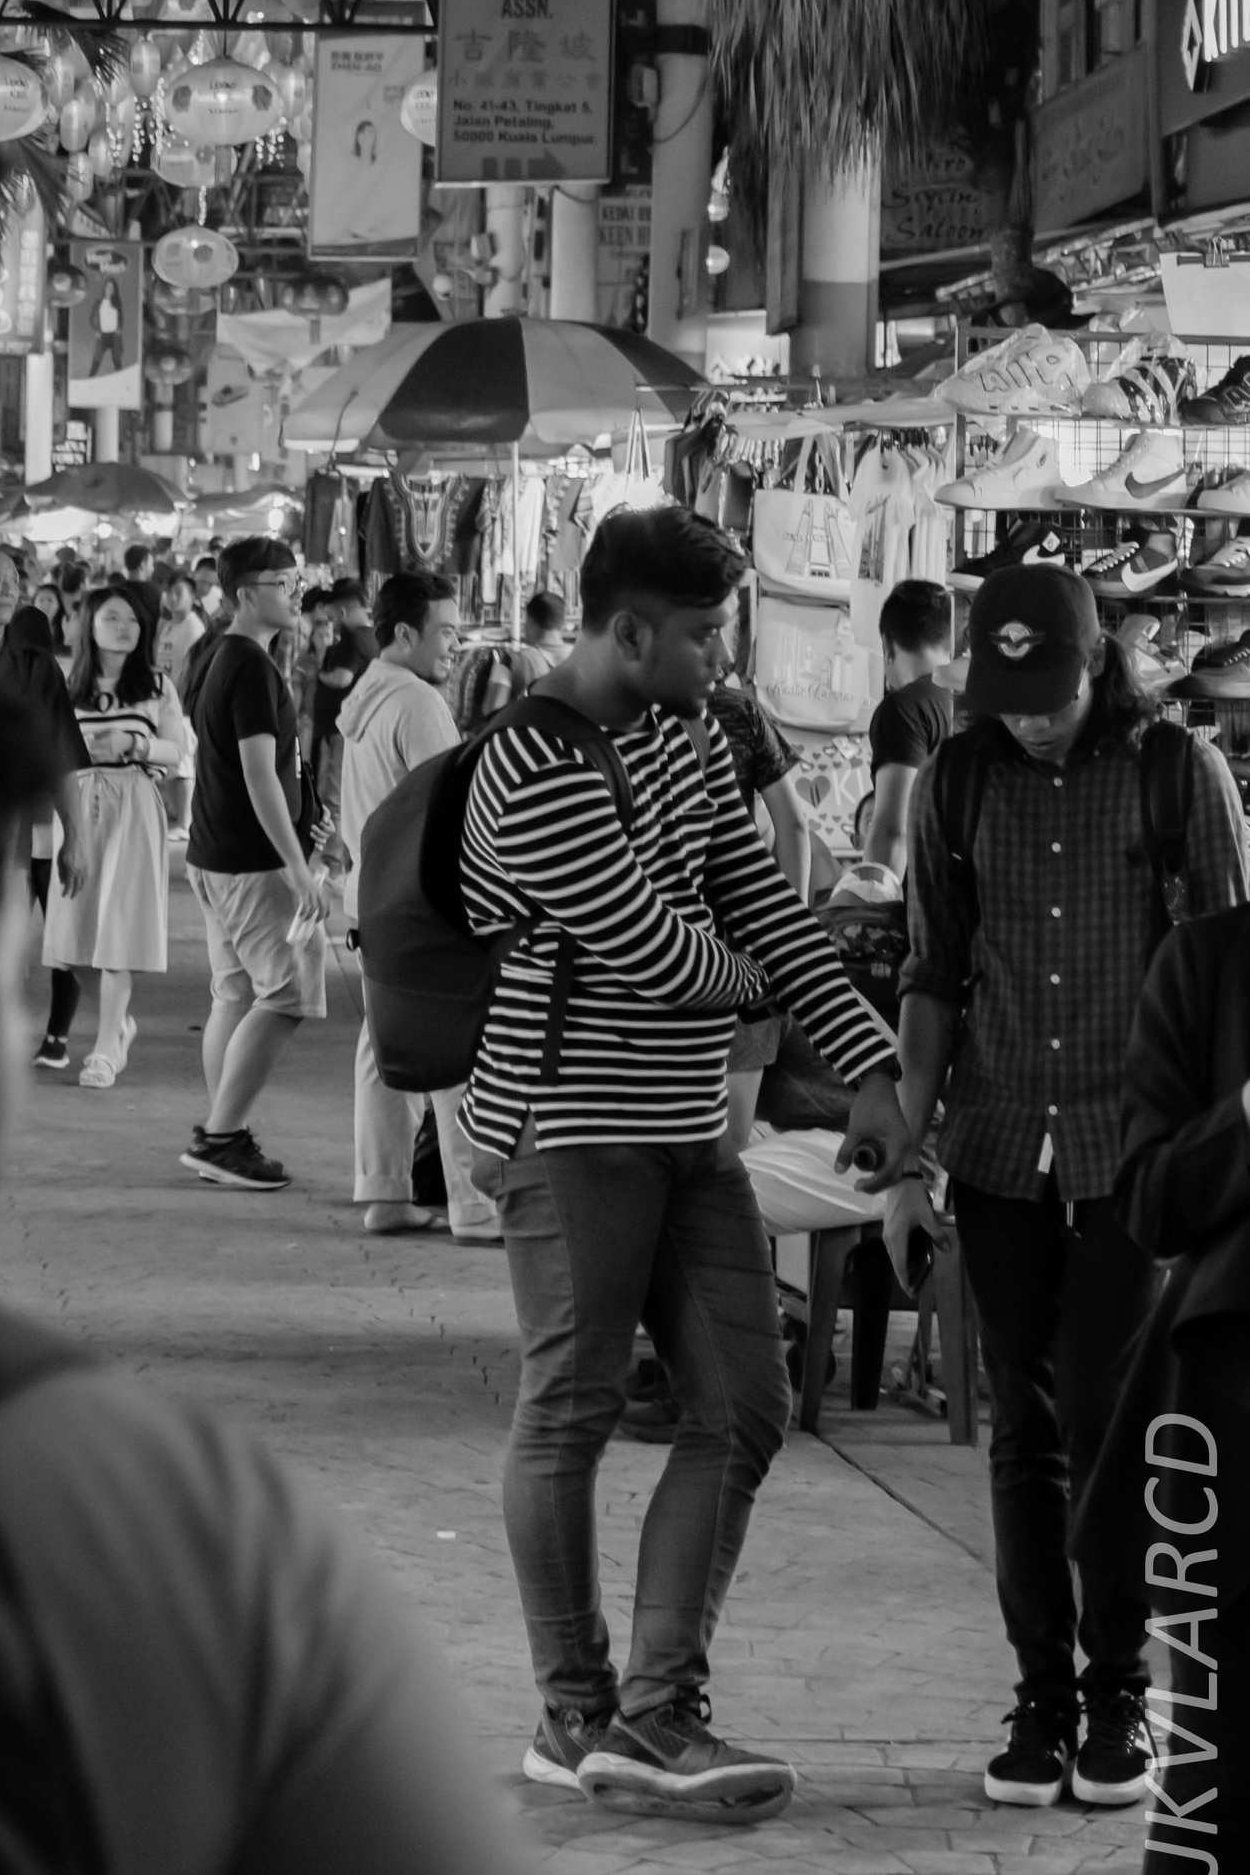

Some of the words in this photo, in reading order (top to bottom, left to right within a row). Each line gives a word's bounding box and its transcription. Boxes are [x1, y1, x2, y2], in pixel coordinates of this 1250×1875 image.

[525, 100, 577, 116] Tingkat
[453, 113, 491, 127] Jalan
[499, 131, 538, 144] Kuala
